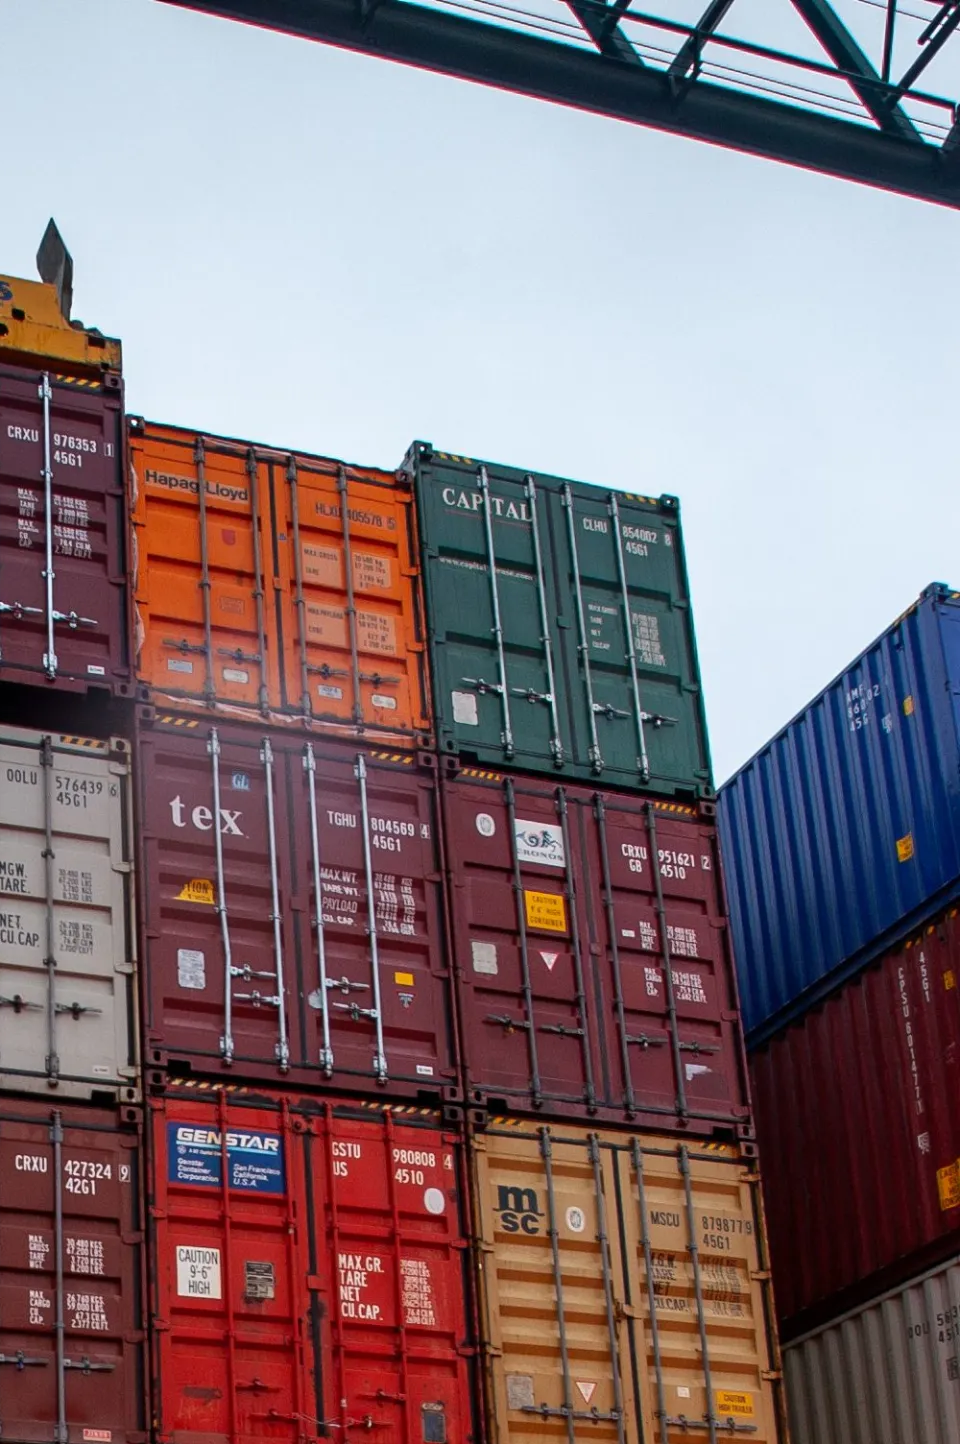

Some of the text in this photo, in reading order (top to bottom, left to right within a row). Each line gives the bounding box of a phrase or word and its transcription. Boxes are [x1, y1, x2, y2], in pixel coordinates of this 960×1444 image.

[7, 425, 114, 458] CRXU 976353 1
[53, 450, 82, 468] 45G1
[442, 487, 533, 522] CAPTAL
[582, 517, 673, 546] CLHU 854002 8
[624, 540, 649, 557] 45G1
[6, 768, 119, 798] OOLU 576439 6
[233, 772, 249, 789] GL
[55, 791, 88, 809] 45G1
[170, 795, 245, 837] tex
[327, 810, 429, 839] TGHU 804569 4
[373, 834, 402, 852] 45G1
[621, 844, 711, 871] CRXU 951621 2
[629, 859, 686, 880] GB 4510
[322, 896, 358, 913] PAYLOAD
[919, 951, 930, 1003] 45G1
[897, 967, 911, 1019] CPSU
[177, 1127, 279, 1153] GENSTAR
[177, 1158, 204, 1167] Genstar
[332, 1142, 452, 1171] GSTU 980808 4
[15, 1154, 47, 1172] CRXU
[64, 1160, 112, 1180] 427324
[178, 1165, 211, 1175] Container
[233, 1164, 248, 1172] San
[333, 1162, 424, 1186] US 4510
[65, 1178, 96, 1195] 42G1
[178, 1172, 219, 1183] Corporation
[650, 1211, 680, 1229] MSCU
[701, 1216, 743, 1234] 879877
[29, 1242, 50, 1252] GROSS
[703, 1233, 731, 1251] 45G1
[29, 1252, 46, 1262] TARE
[178, 1248, 218, 1265] CAUTION
[188, 1279, 210, 1295] HIGH
[339, 1269, 368, 1288] TARE
[29, 1297, 50, 1308] CARGO
[339, 1286, 360, 1302] NET
[718, 1403, 731, 1411] HIGH
[723, 1394, 747, 1404] CAUTION
